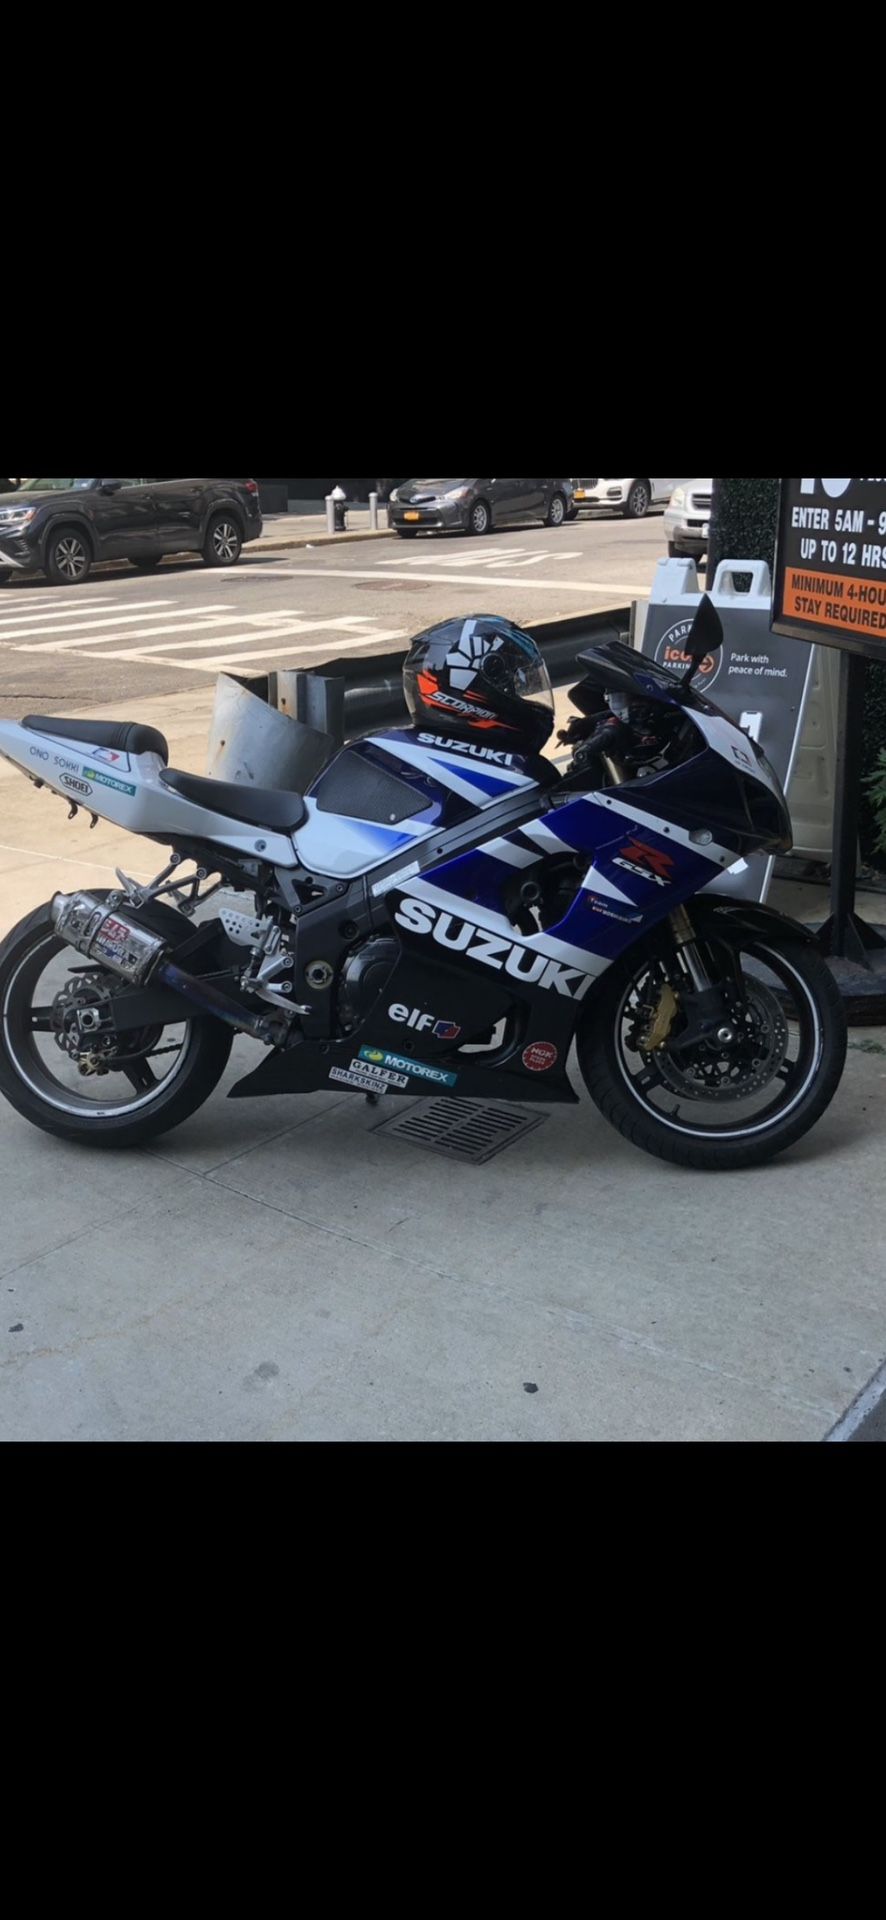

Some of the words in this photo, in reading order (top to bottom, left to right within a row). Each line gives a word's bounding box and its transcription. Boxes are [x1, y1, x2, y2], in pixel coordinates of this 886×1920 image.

[791, 506, 830, 530] ENTER
[834, 509, 864, 533] 5AM
[800, 538, 816, 560] UP
[821, 540, 837, 563] TO
[842, 542, 857, 565] 12
[861, 544, 886, 569] HRS
[791, 574, 844, 598] MINIMUM
[794, 596, 822, 616] STAY
[825, 602, 886, 630] REQUIRED
[662, 661, 691, 669] PARKIN
[664, 646, 692, 662] ico
[730, 652, 749, 663] Park
[750, 653, 769, 664] with
[728, 665, 752, 676] peace
[754, 666, 764, 675] of
[764, 667, 788, 677] mind.
[29, 746, 50, 761] ONO
[417, 732, 513, 766] SUZUKI
[63, 775, 90, 793] SHOEI
[95, 772, 135, 794] MOTOREX
[394, 898, 596, 1000] SUZUKI
[387, 1002, 435, 1032] elf
[530, 1047, 553, 1058] NGK
[331, 1067, 386, 1090] SHARKSKINZ
[352, 1060, 407, 1084] GALFER
[384, 1054, 449, 1083] MOTOREX
